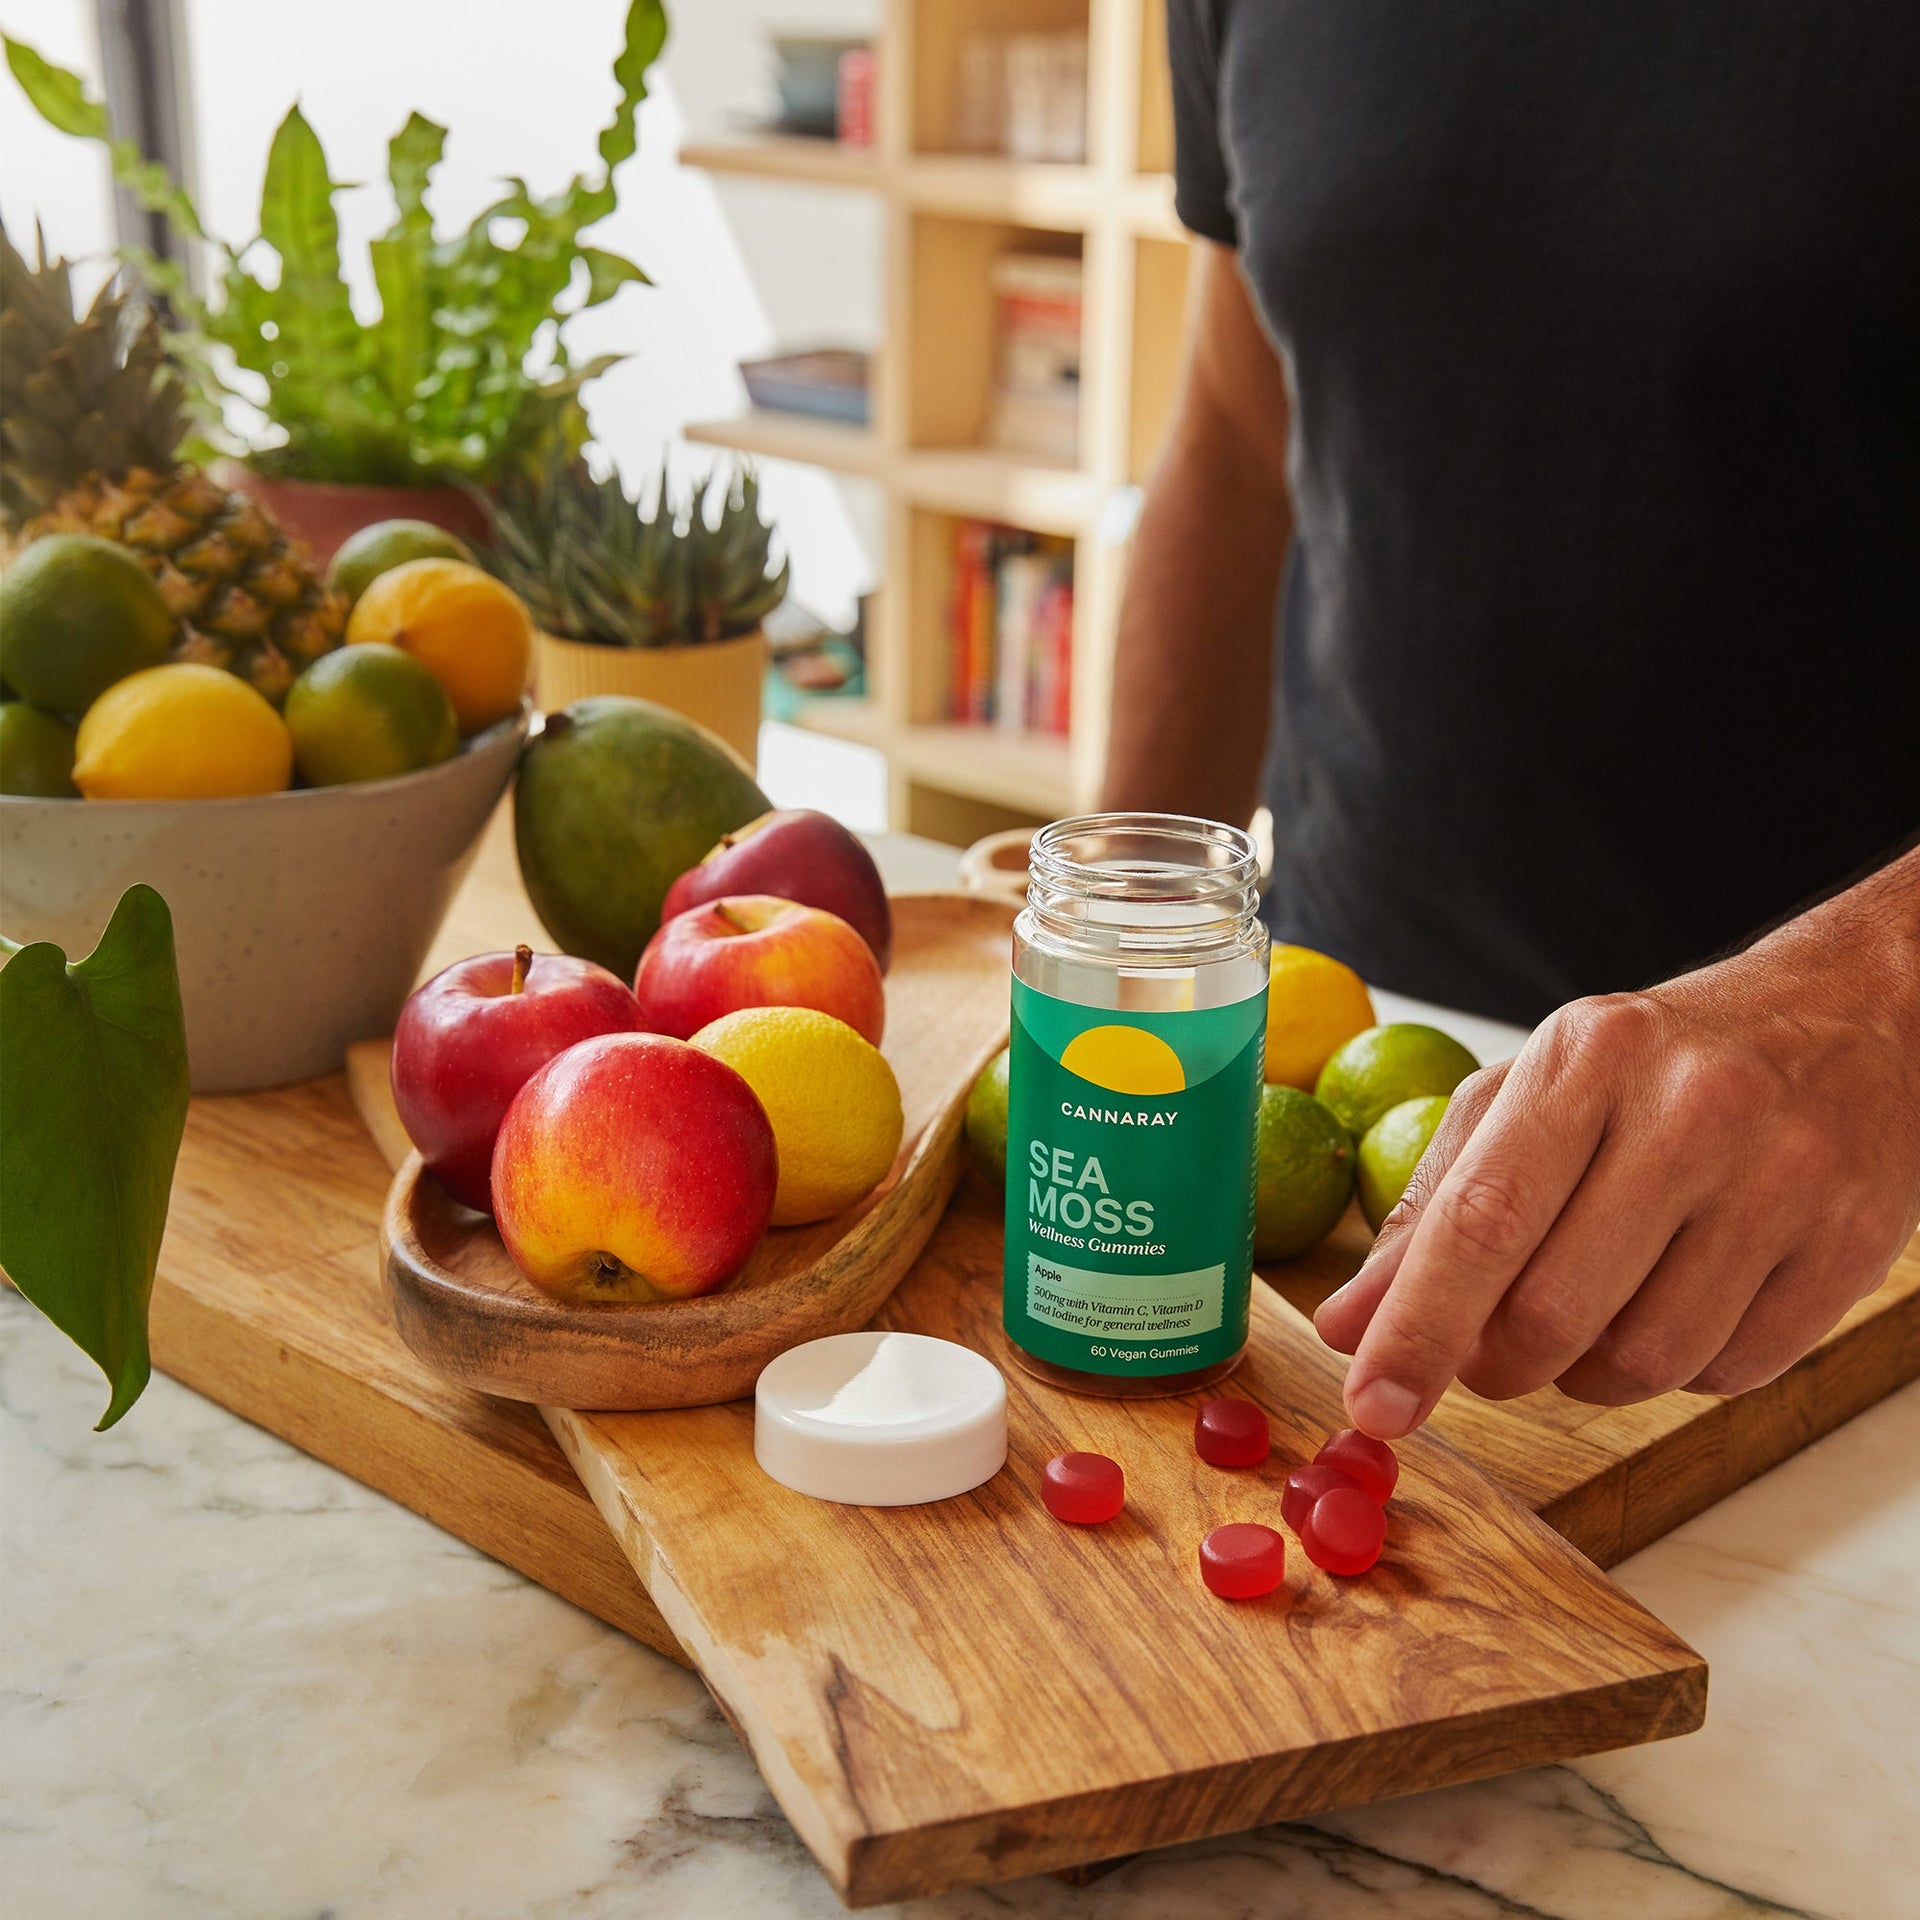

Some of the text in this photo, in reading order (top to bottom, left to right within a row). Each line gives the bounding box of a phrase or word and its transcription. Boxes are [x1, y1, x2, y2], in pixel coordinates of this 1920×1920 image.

[1061, 1102, 1179, 1126] CANNARAY
[1029, 1140, 1109, 1195] SEA
[1029, 1178, 1155, 1237] MOSS
[1028, 1218, 1166, 1256] Wellness Gummies
[1035, 1264, 1062, 1282] Apple
[1034, 1285, 1204, 1317] 500mg with Vitamin C, Vitamin D
[1033, 1302, 1191, 1332] and Iodine for general wellness
[1090, 1344, 1199, 1361] 60 Vegan Gummies
